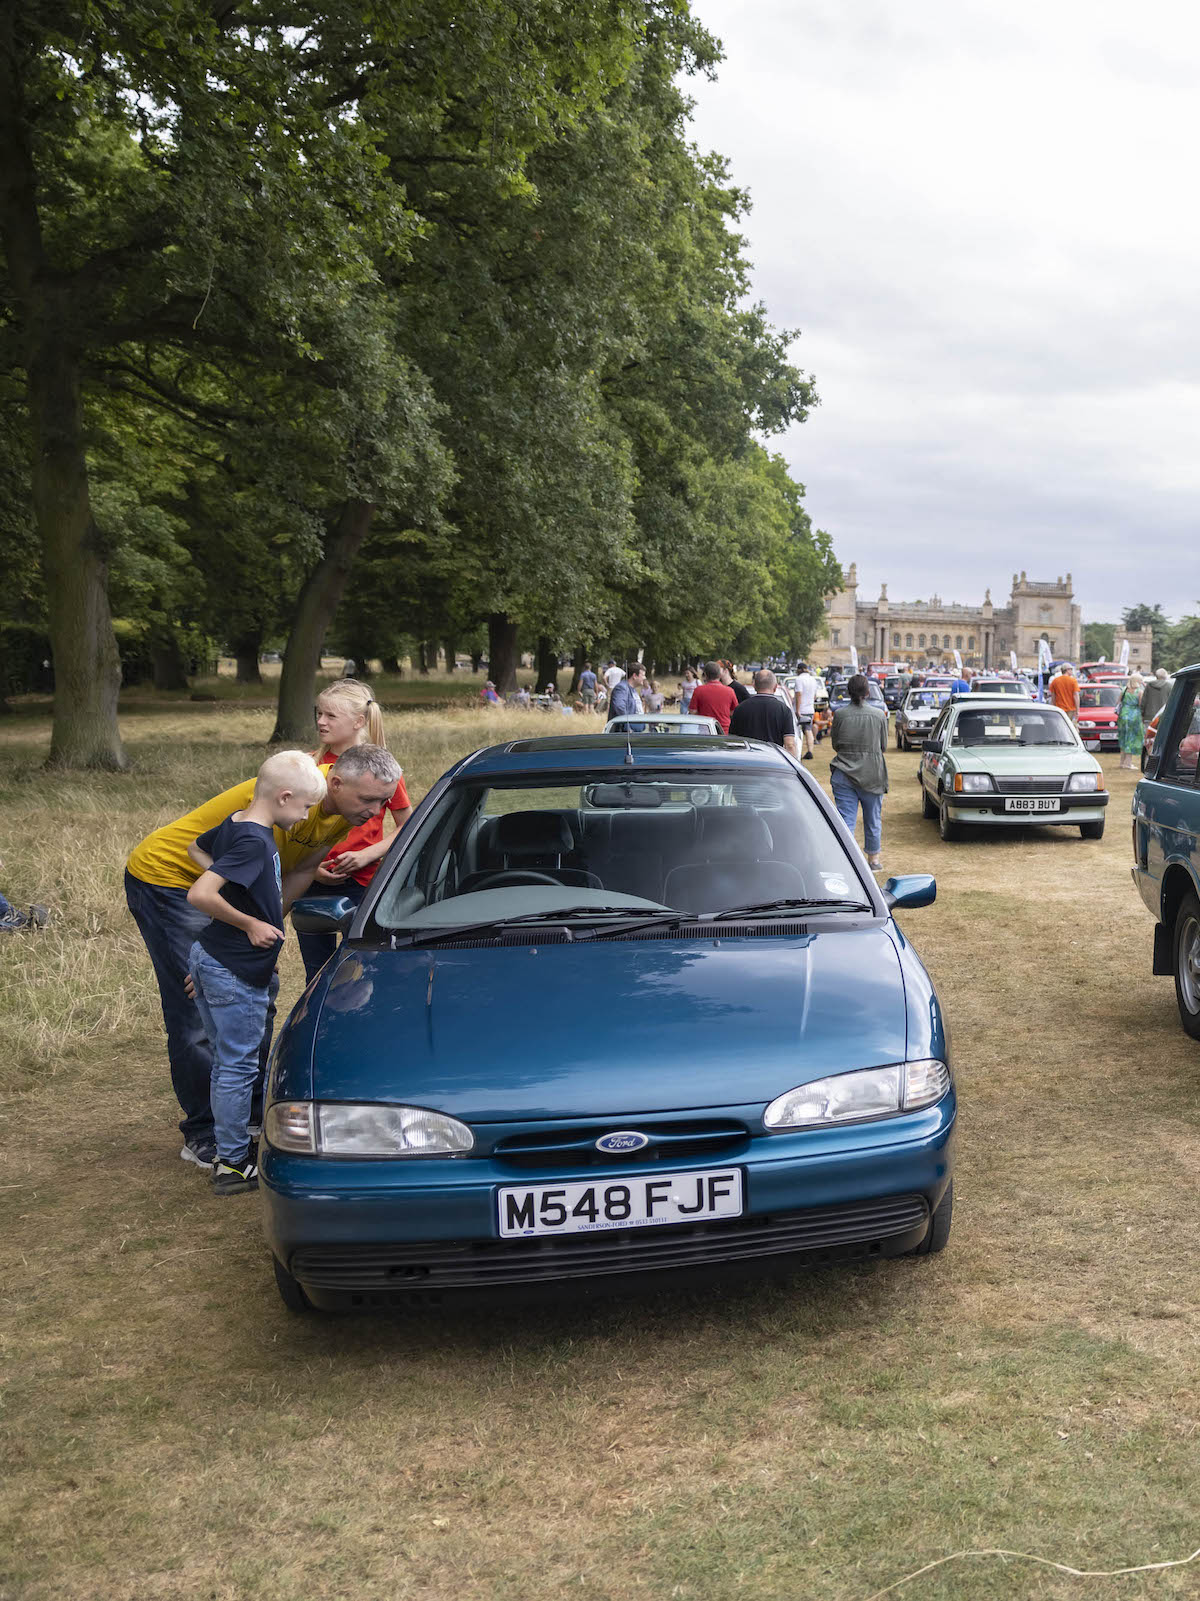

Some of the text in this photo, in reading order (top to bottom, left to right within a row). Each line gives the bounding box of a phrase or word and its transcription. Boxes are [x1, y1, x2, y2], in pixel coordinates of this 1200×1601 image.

[1010, 800, 1056, 809] A883 BUY
[608, 1135, 637, 1149] Ford
[506, 1174, 735, 1229] M548 FJF
